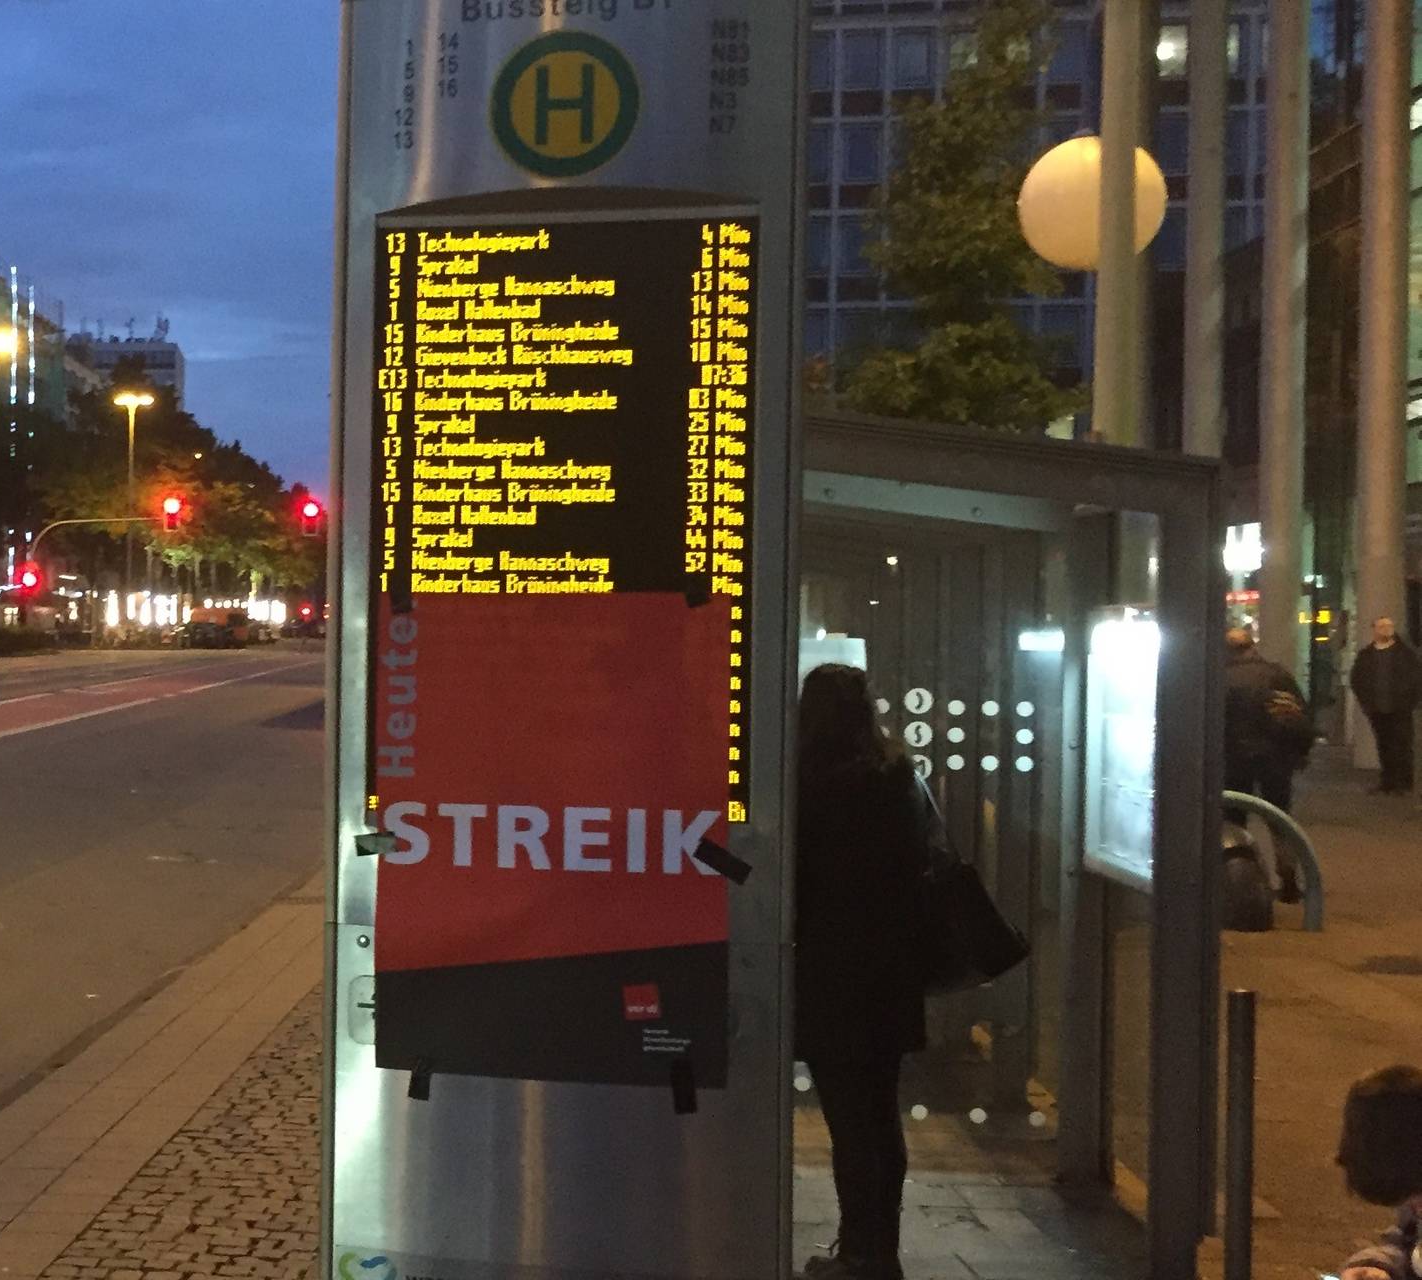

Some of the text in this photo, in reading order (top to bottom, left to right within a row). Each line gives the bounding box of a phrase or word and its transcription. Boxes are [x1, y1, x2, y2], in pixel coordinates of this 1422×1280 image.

[406, 39, 414, 56] 1
[438, 32, 459, 51] 14
[405, 61, 415, 80] 5
[438, 55, 458, 74] 15
[438, 78, 458, 98] 16
[535, 63, 595, 145] H
[394, 107, 414, 126] 12
[394, 130, 414, 149] 13
[386, 223, 750, 253] 13 Technologiepark 4 Min
[390, 256, 400, 276] 9
[417, 254, 479, 277] Sprakel
[719, 247, 749, 267] Min
[390, 278, 400, 298] 5
[694, 271, 712, 291] 13
[719, 271, 749, 291] Min
[389, 301, 397, 321] 1
[691, 294, 712, 315] 14
[718, 294, 748, 314] Min
[384, 318, 748, 343] 15 Kinderhaus Brüningheide 15 Min
[385, 346, 403, 366] 12
[415, 345, 507, 366] Gievenbeck
[717, 341, 747, 361] Min
[379, 369, 407, 389] E13
[417, 367, 546, 390] Technologiepark
[383, 392, 402, 411] 16
[415, 391, 503, 411] Kinderhaus
[510, 390, 617, 412] Brüningheide
[716, 388, 746, 408] Min
[387, 411, 746, 435] 9 Sprakel 25 Min
[382, 435, 745, 459] 13 Technologiepark 27 Min
[386, 460, 396, 479] 5
[715, 459, 745, 478] Min
[381, 482, 744, 504] 15 Kinderhaus Brüningheide 33 Min
[386, 505, 393, 524] 1
[687, 505, 707, 525] 34
[714, 505, 744, 525] Min
[385, 528, 743, 549] 9 Sprakel 44 Min
[384, 551, 394, 569] 5
[686, 552, 706, 572] 52
[713, 552, 743, 572] Min
[411, 573, 500, 593] Kinderhaus
[384, 801, 721, 876] STREIK
